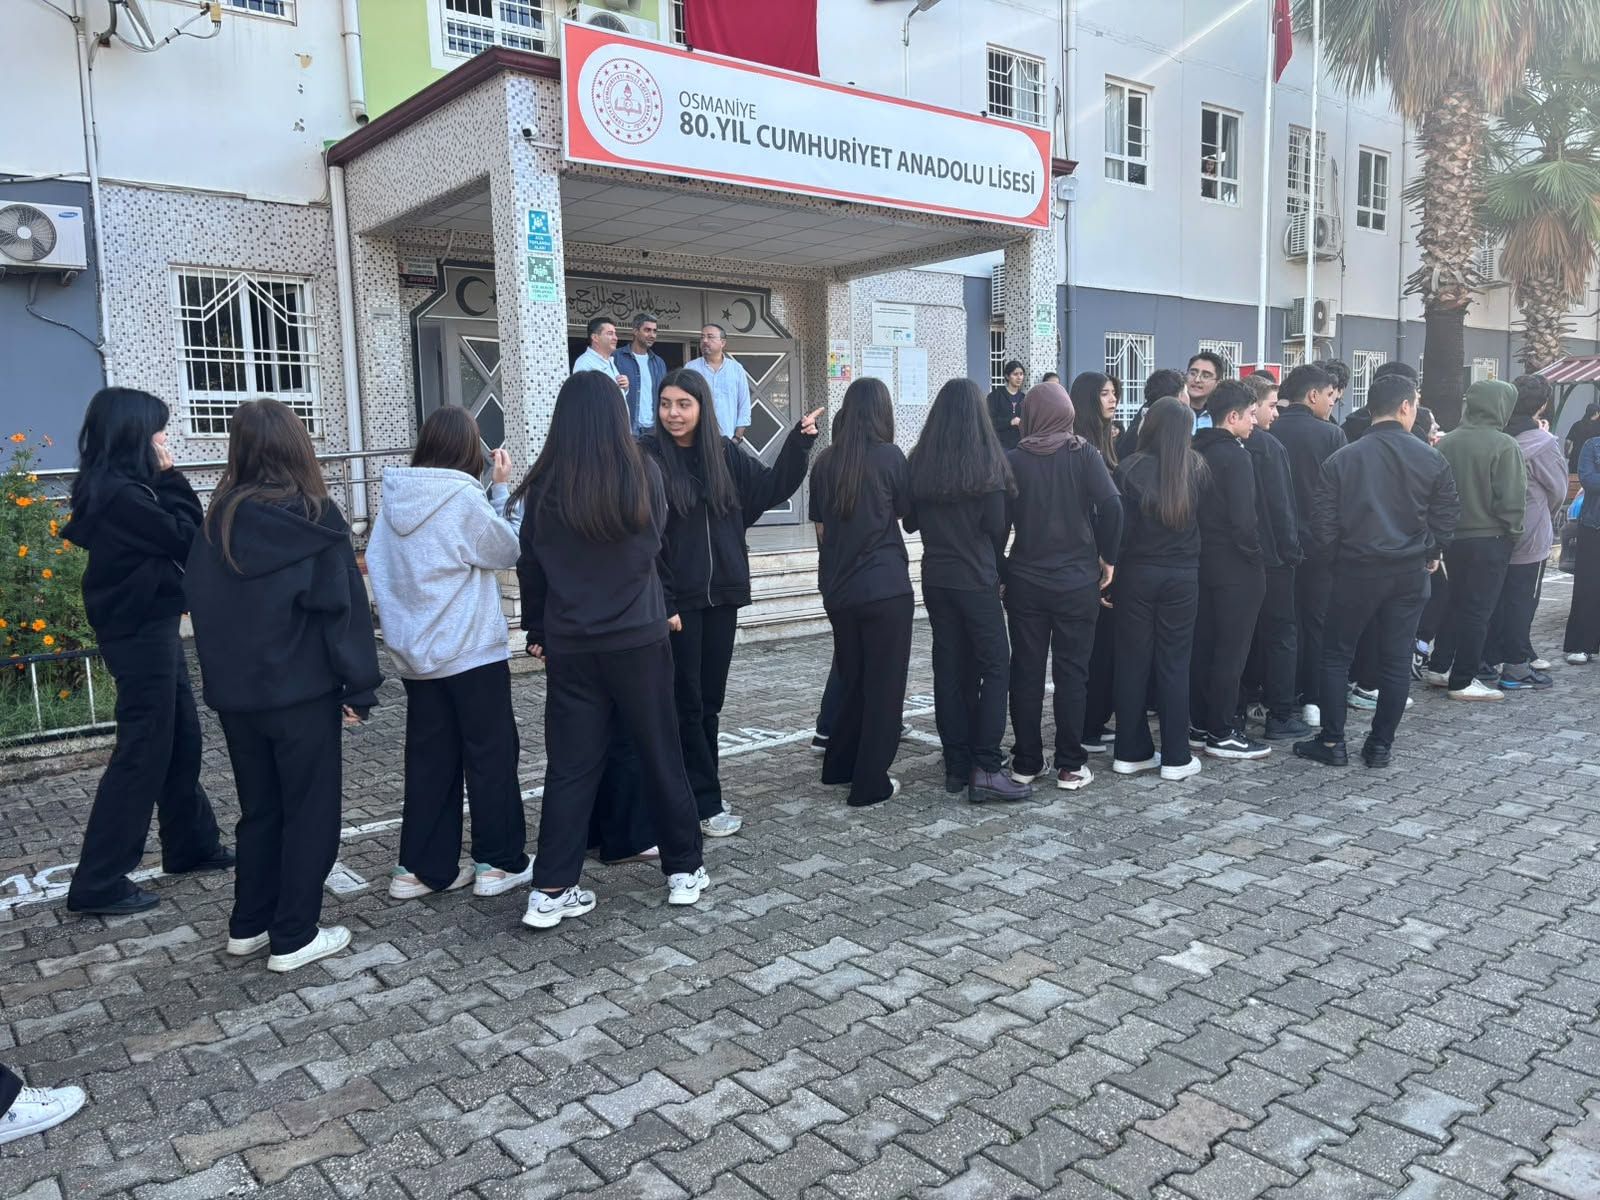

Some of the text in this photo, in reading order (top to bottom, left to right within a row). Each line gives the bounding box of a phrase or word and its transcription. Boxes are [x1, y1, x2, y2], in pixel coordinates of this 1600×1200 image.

[678, 90, 757, 120] OSMANİYE
[679, 111, 1036, 196] 80.YIL CUMHURİYET ANADOLU LİSESİ
